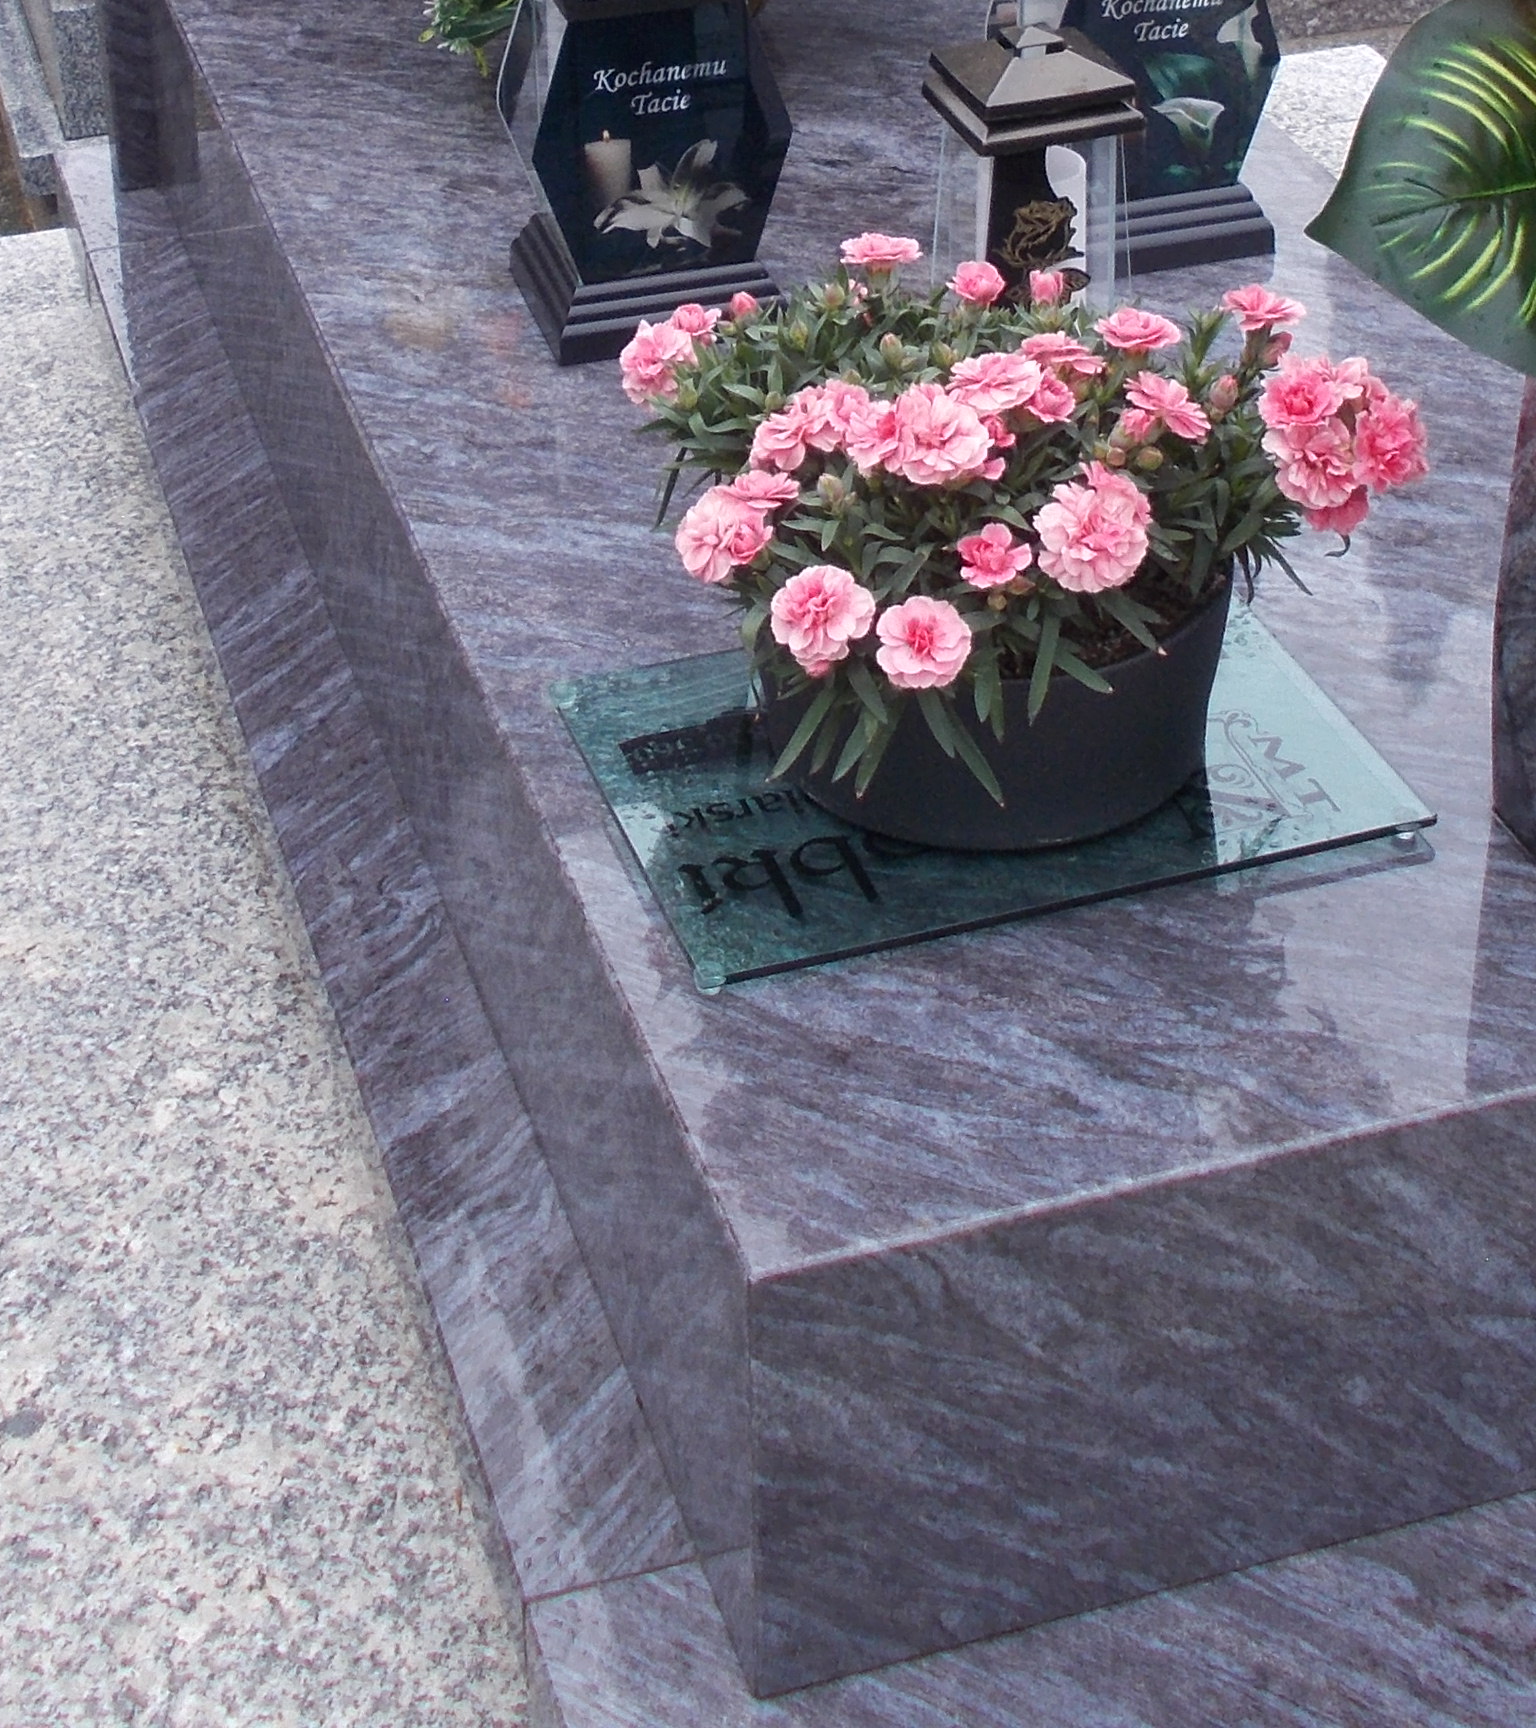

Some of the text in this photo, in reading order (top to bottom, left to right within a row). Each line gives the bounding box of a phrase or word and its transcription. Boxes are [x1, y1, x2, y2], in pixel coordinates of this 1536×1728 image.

[1133, 17, 1190, 43] Tacie
[592, 58, 727, 94] Kochanemu
[630, 87, 692, 116] Tacie
